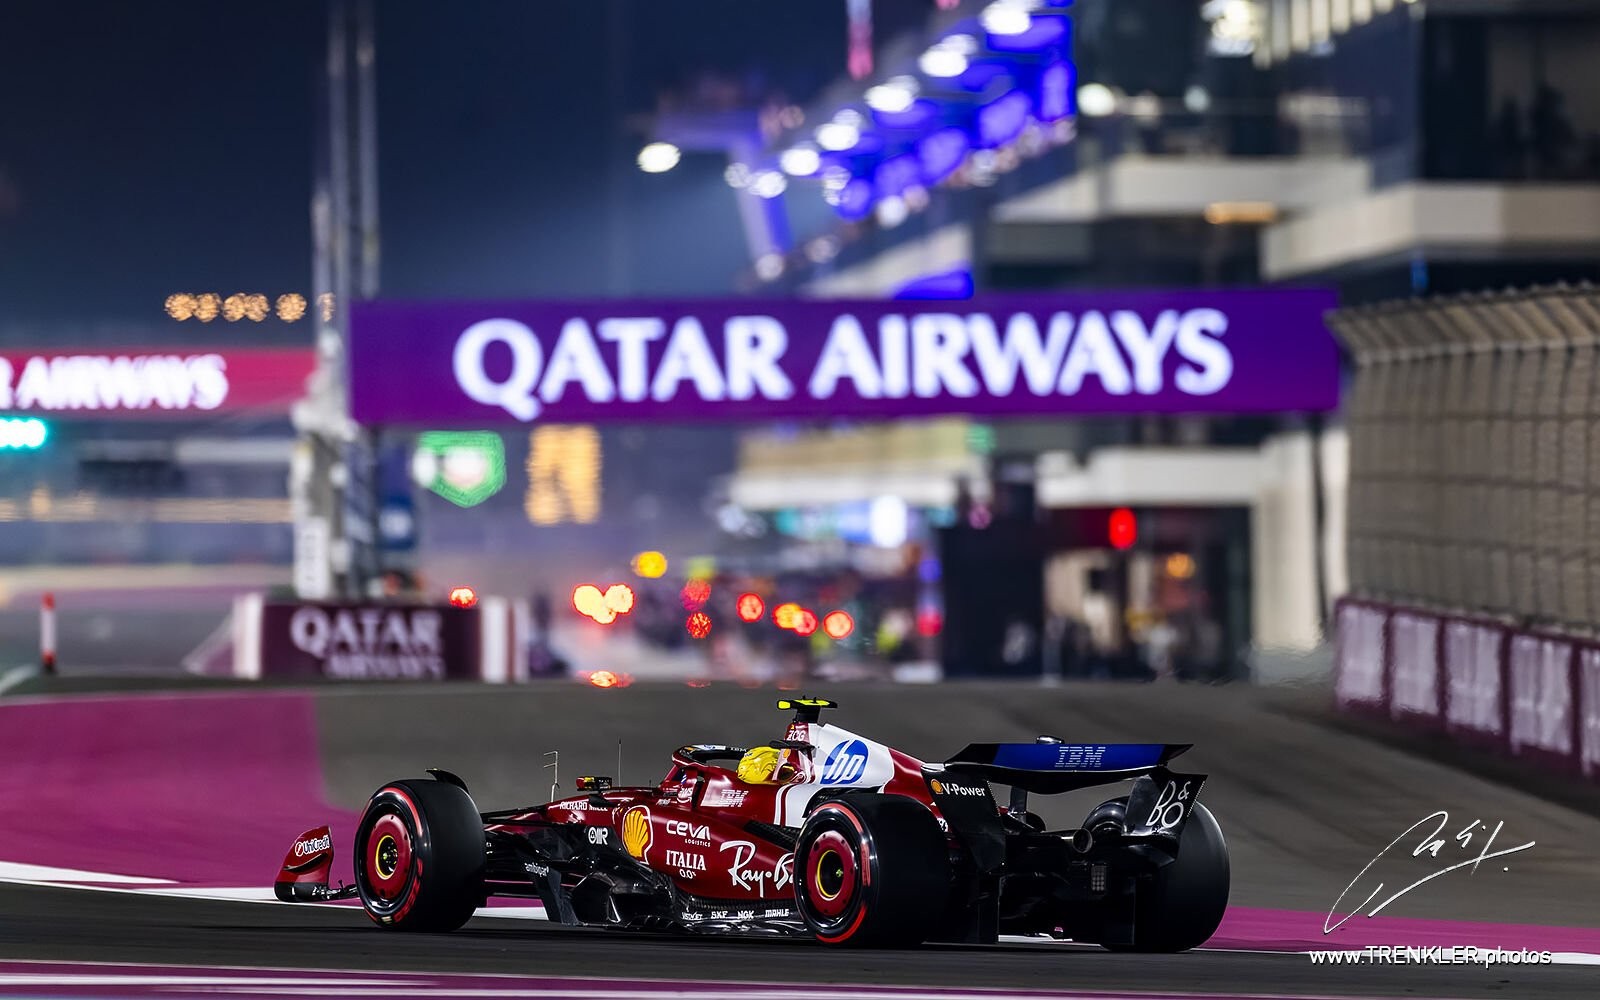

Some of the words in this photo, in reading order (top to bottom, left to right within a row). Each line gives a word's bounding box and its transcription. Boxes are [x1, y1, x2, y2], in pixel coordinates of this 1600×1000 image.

[453, 314, 795, 422] QATAR
[808, 308, 1234, 400] AIRWAYS
[290, 606, 442, 659] QATAR
[823, 739, 866, 784] hp
[1054, 746, 1106, 767] IBM
[942, 782, 986, 797] V-Power
[559, 801, 588, 810] RICHARD
[684, 839, 711, 847] LOGISTICS
[665, 849, 707, 871] ITALIA
[737, 910, 755, 920] NGK
[764, 908, 790, 918] MAHLE
